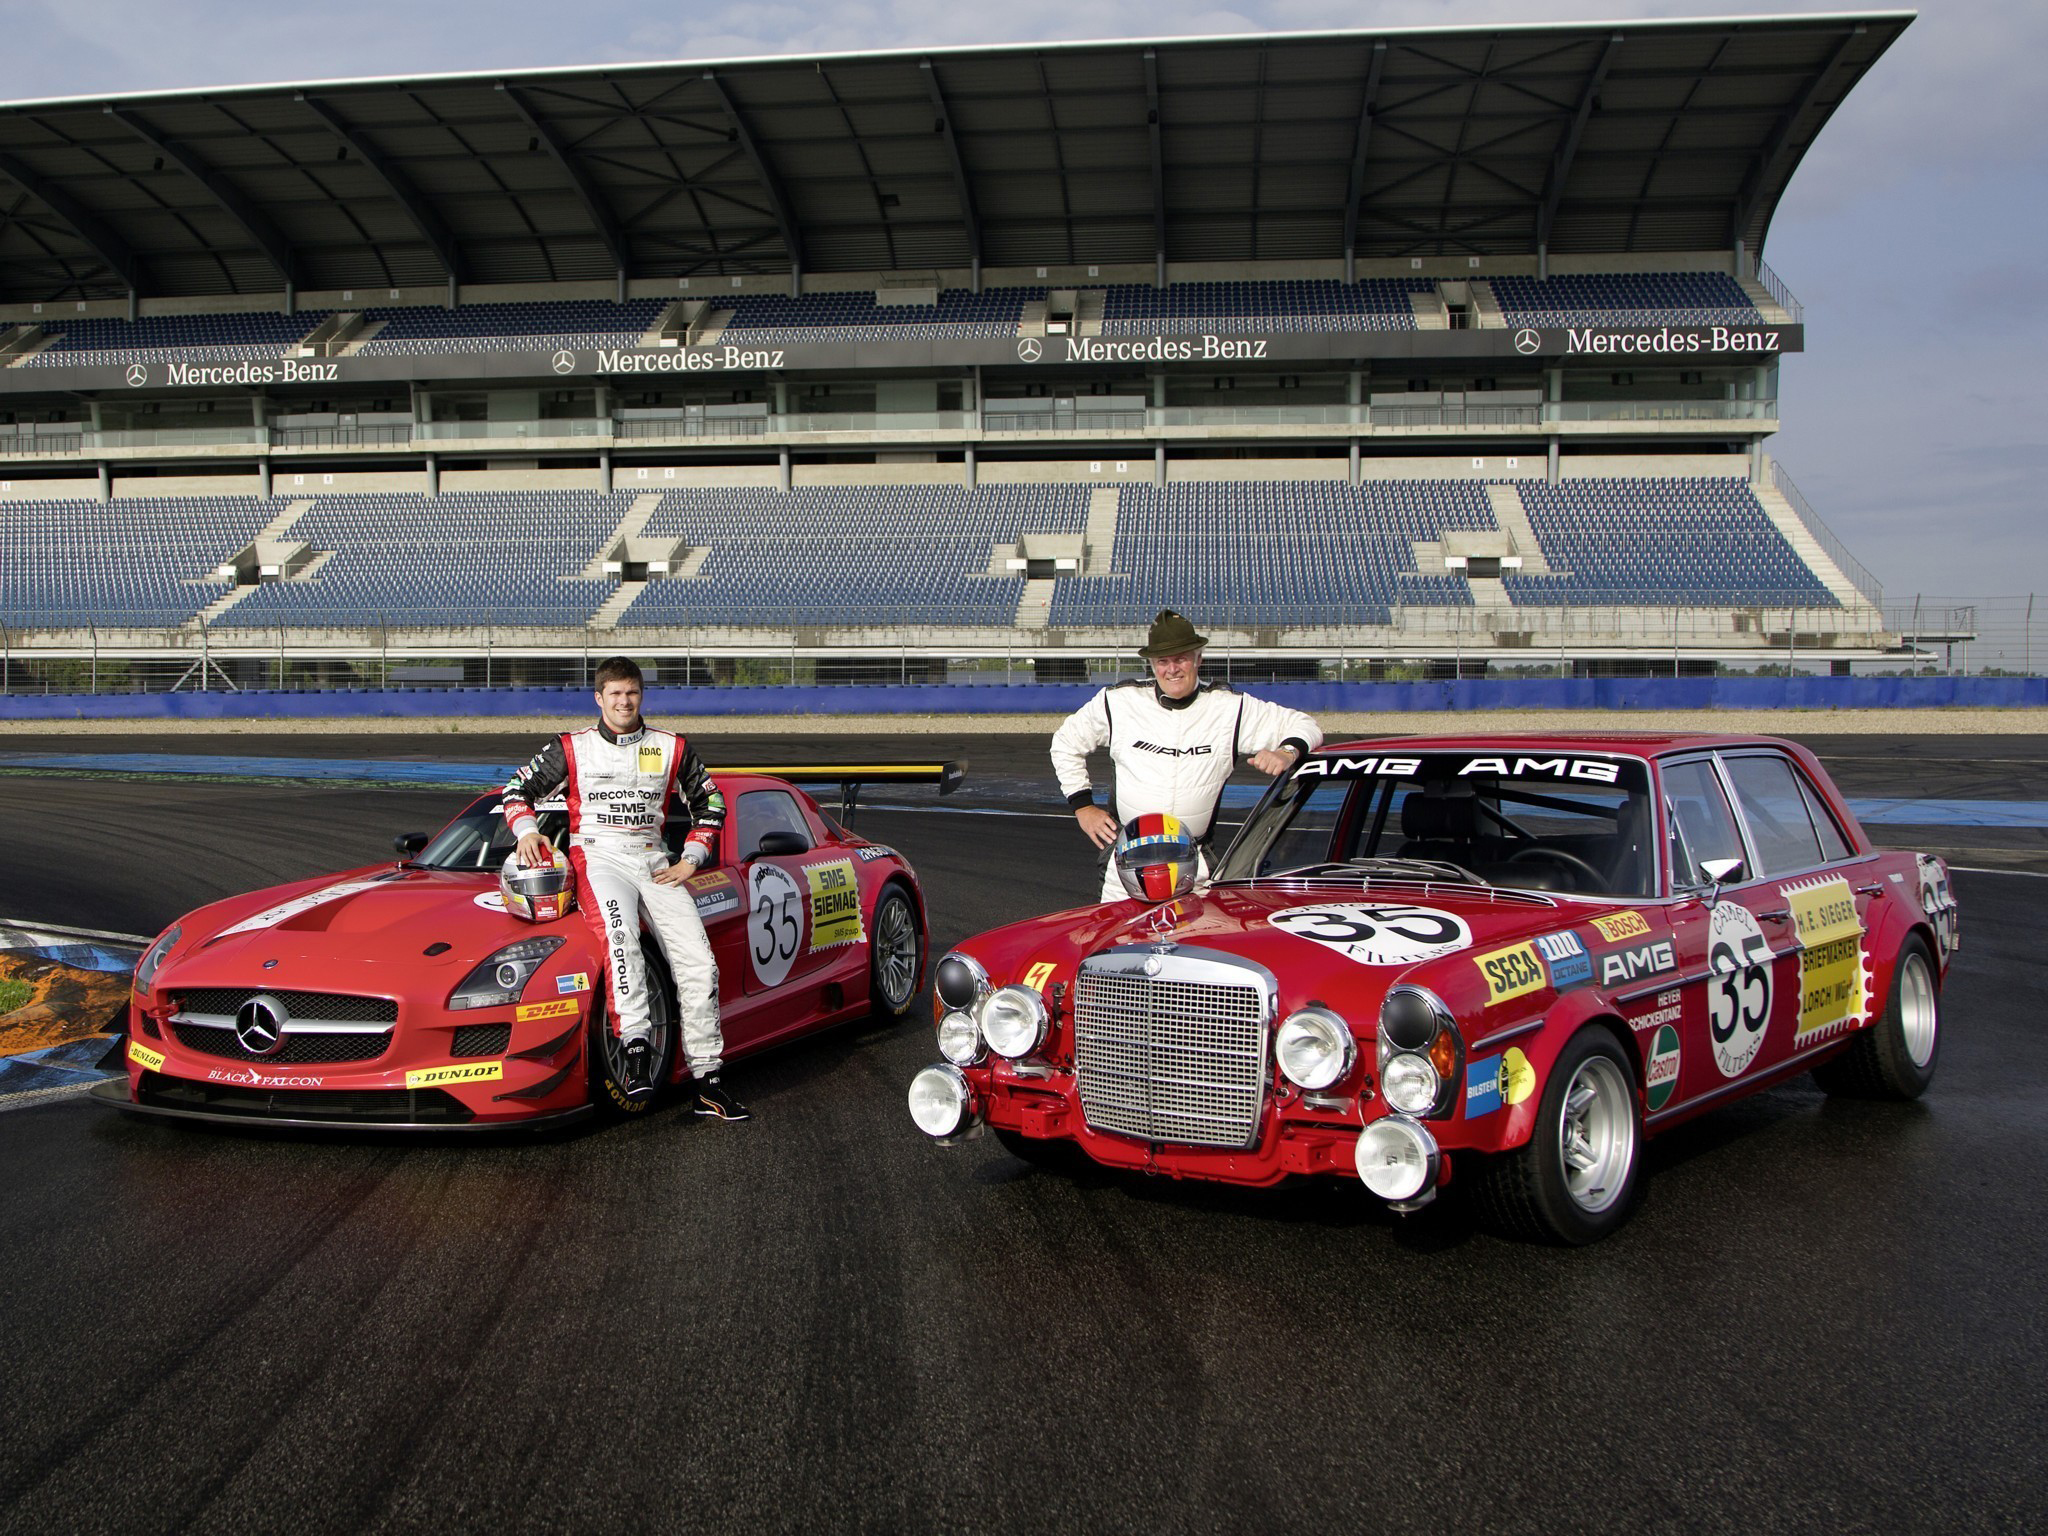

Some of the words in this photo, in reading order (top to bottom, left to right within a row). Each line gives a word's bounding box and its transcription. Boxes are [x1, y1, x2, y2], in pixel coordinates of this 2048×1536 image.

[1066, 335, 1267, 361] Mercedes-Benz
[1566, 327, 1779, 353] Mercedes-Benz
[596, 346, 784, 373] Mercedes-Benz
[166, 360, 338, 386] Mercedes-Benz
[640, 747, 662, 756] ADAC
[1155, 744, 1212, 758] AMG
[1290, 758, 1422, 780] AMG
[1457, 758, 1620, 783] AMG
[588, 789, 661, 802] precote.com
[610, 803, 646, 813] SMS
[596, 813, 656, 826] SIEMAG
[694, 874, 724, 887] DHL
[819, 868, 847, 890] SMS
[696, 895, 711, 907] AMG
[711, 892, 725, 902] GT3
[814, 890, 857, 917] SIEMAG
[606, 899, 623, 929] SMS
[1272, 907, 1462, 945] 35
[1608, 913, 1647, 938] BOSCH
[1713, 905, 1753, 935] CAMEL
[1819, 900, 1855, 927] SIEGER
[755, 891, 799, 966] 35
[1347, 944, 1462, 963] FILTERS
[1540, 931, 1584, 962] 100
[1803, 939, 1858, 972] BRIEFMARKEN
[613, 947, 630, 995] group
[1484, 950, 1542, 994] SECA
[1553, 961, 1590, 980] OCTANE
[1603, 941, 1676, 986] AMG
[1657, 988, 1681, 1007] HEYER
[1711, 934, 1770, 1043] 35
[526, 1002, 570, 1018] DHL
[1628, 1005, 1682, 1032] SCHICKENTANZ
[131, 1048, 162, 1066] DUNLOP
[1718, 1034, 1762, 1074] FILTERS
[208, 1070, 249, 1084] BLACK
[262, 1077, 323, 1086] FALCON
[424, 1066, 499, 1082] DUNLOP
[1648, 1052, 1679, 1082] Castrol
[1467, 1078, 1498, 1099] BILSTEIN
